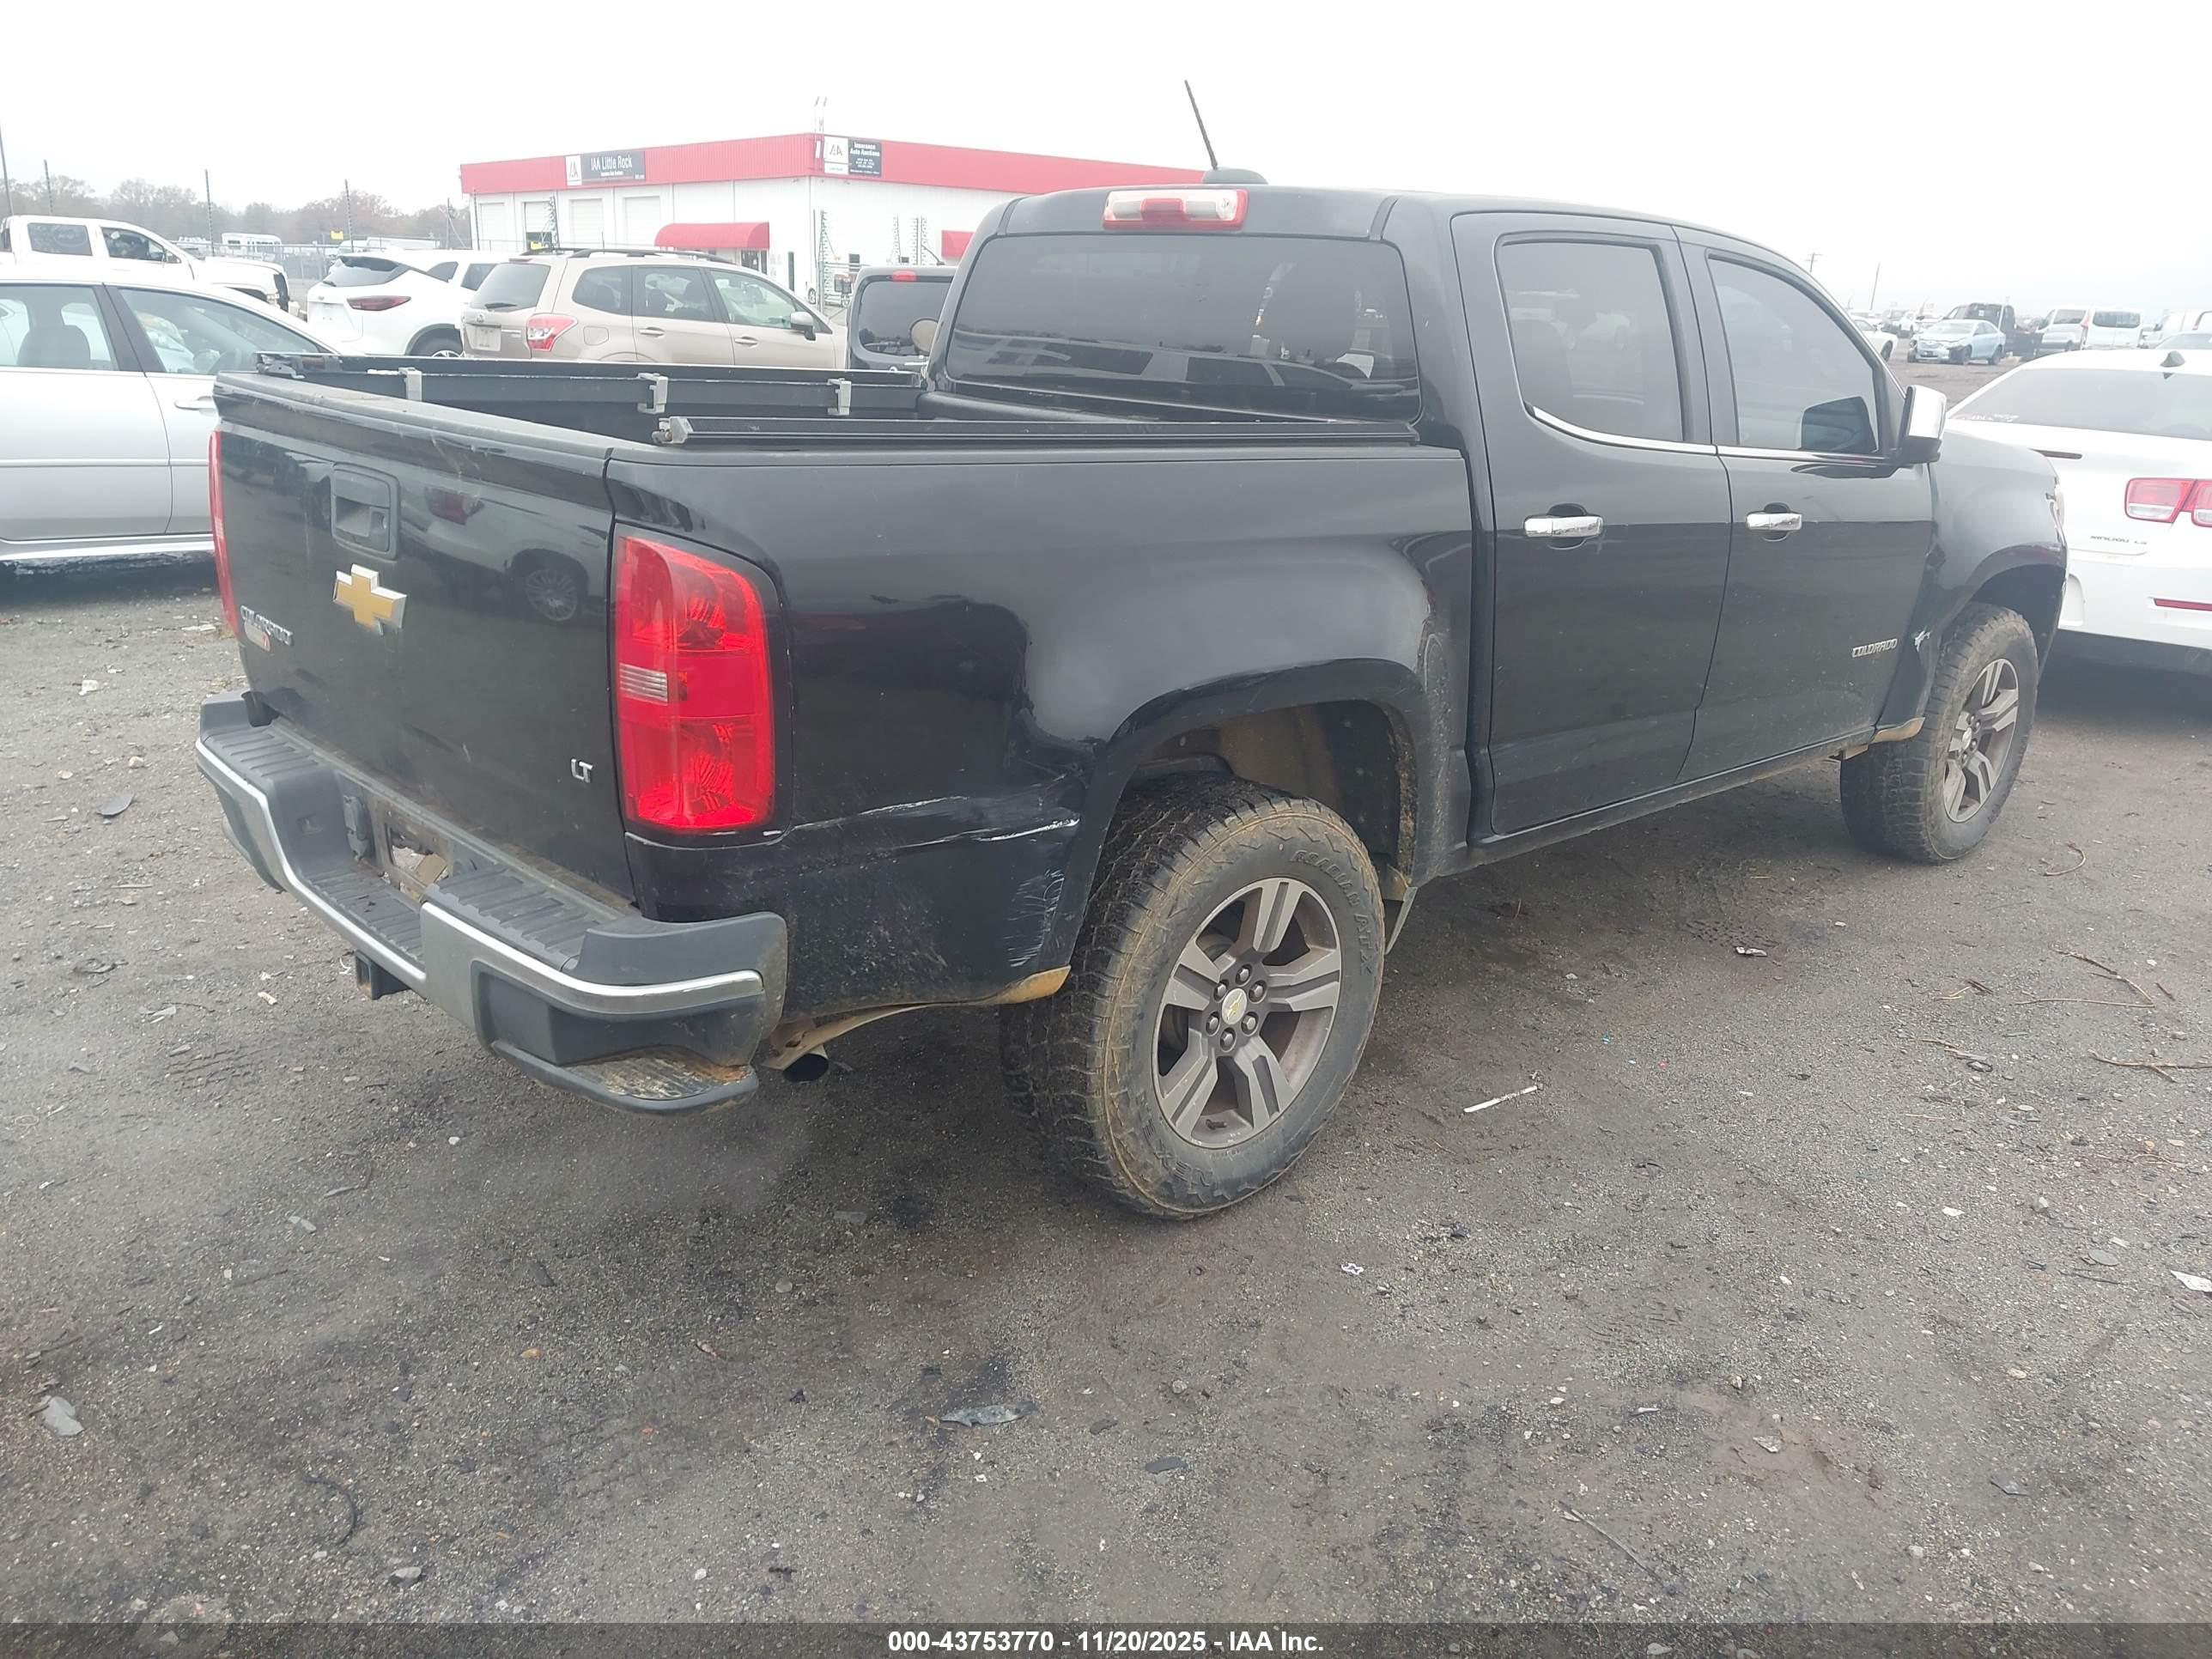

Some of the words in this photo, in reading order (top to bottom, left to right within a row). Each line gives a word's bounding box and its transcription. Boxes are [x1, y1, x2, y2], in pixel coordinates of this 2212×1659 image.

[601, 155, 617, 170] Little
[617, 154, 633, 169] Rock
[1852, 638, 1898, 658] COLORADO
[571, 758, 593, 783] LT
